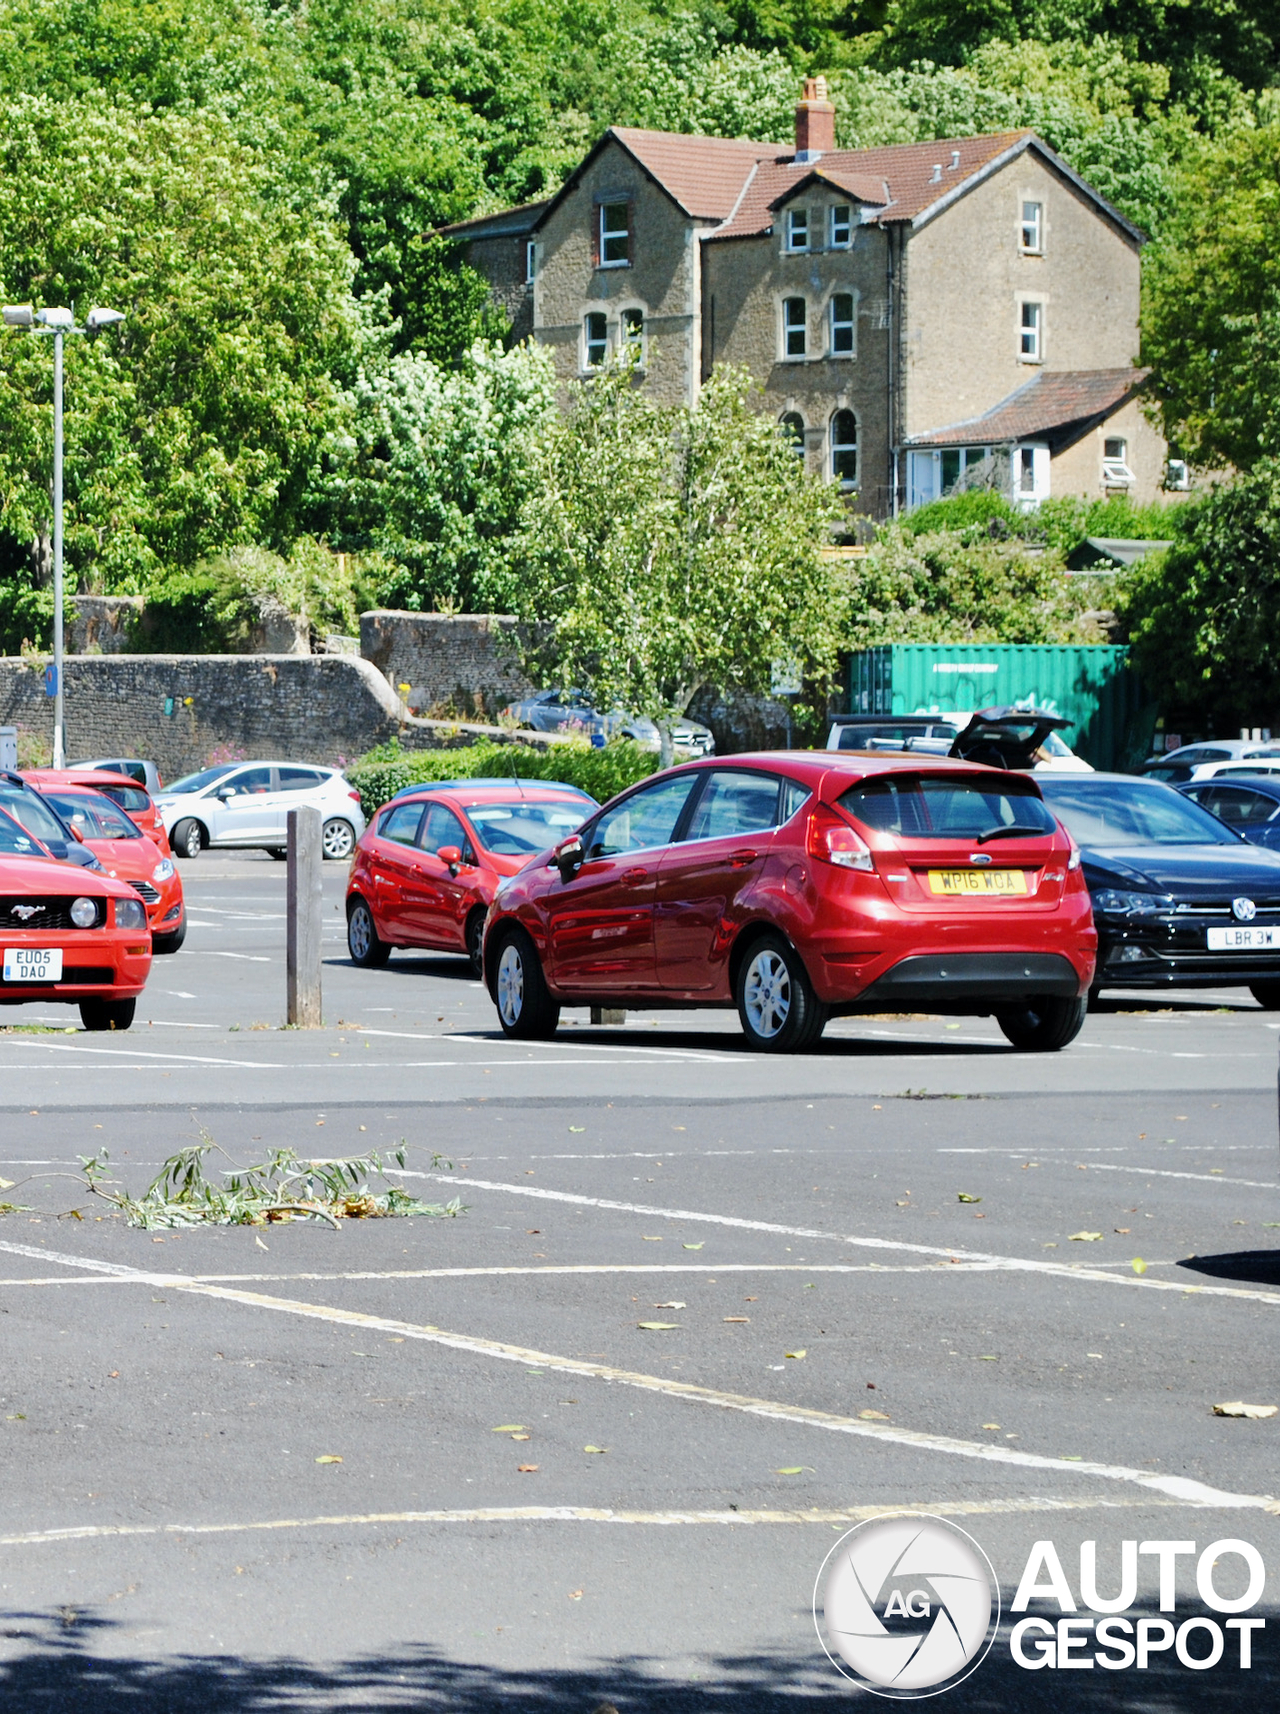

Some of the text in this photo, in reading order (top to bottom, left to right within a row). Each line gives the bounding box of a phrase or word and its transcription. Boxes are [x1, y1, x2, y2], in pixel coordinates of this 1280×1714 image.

[940, 873, 979, 889] WP16
[1225, 930, 1273, 946] LBR 3W
[20, 965, 46, 978] DAO
